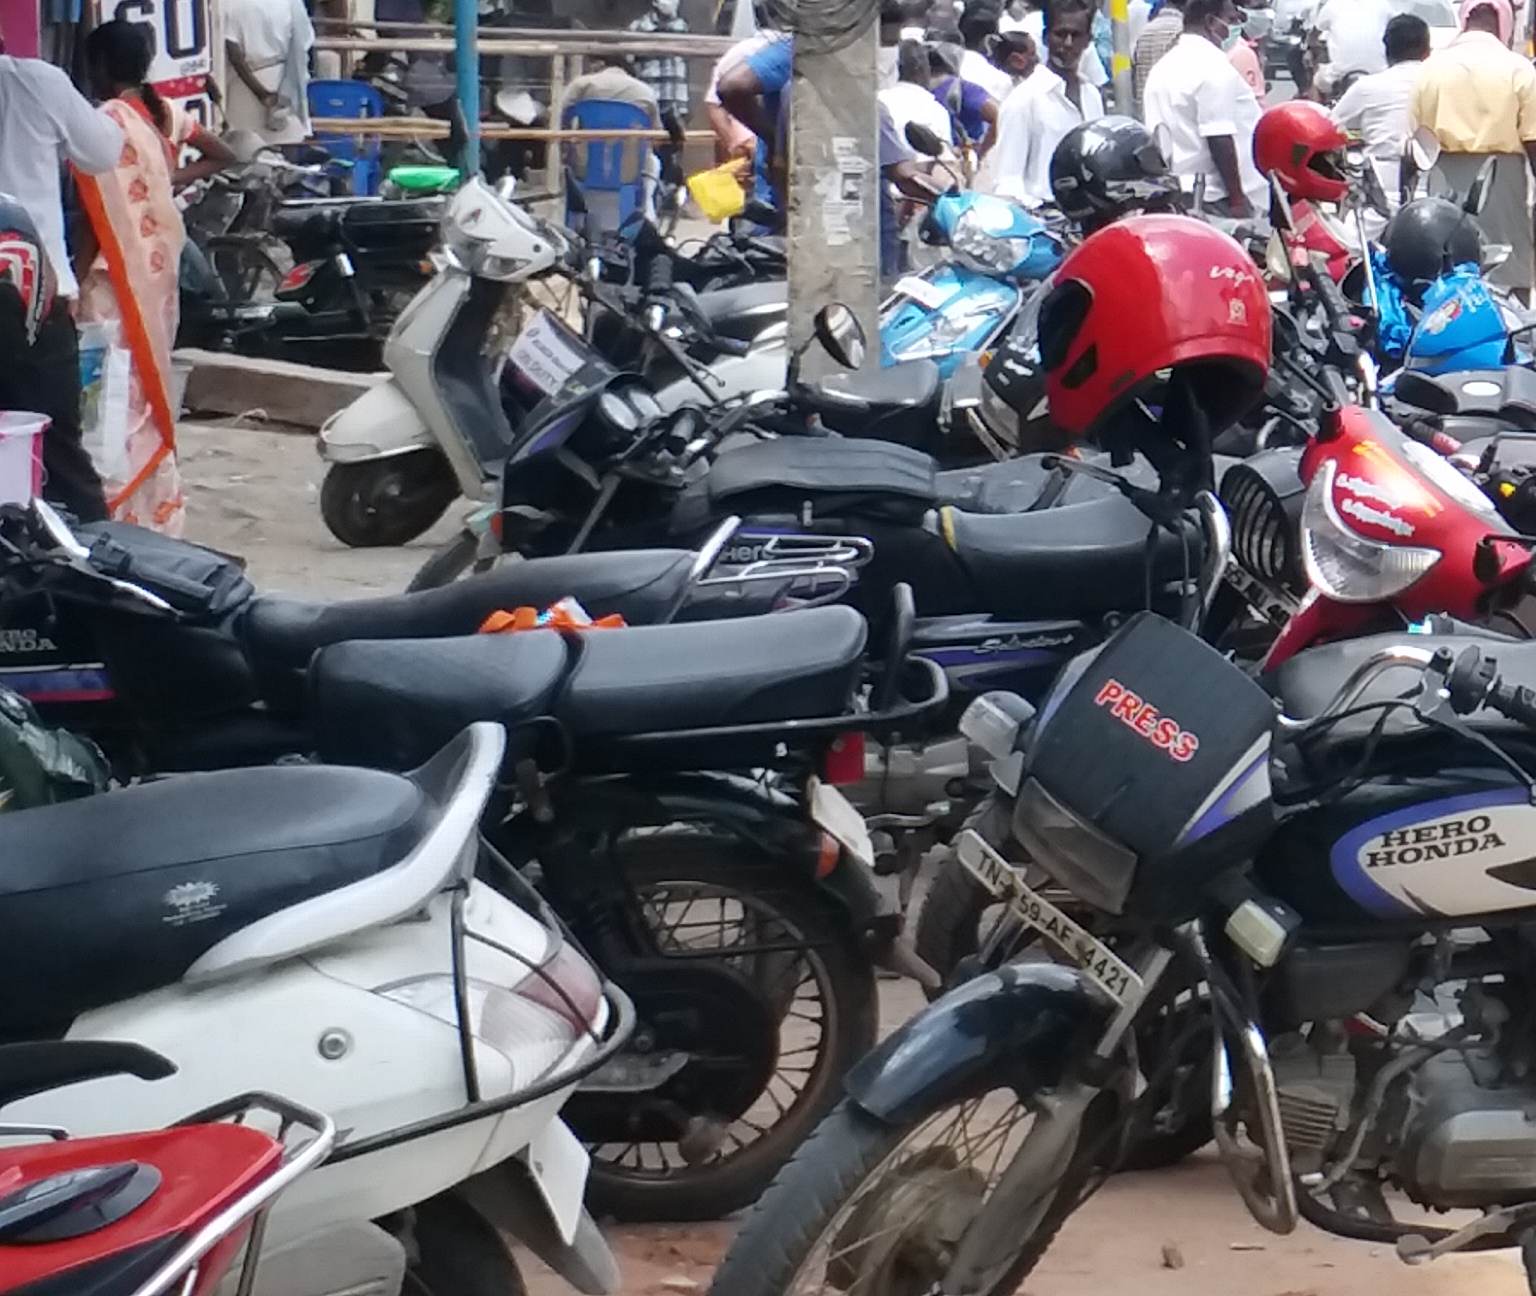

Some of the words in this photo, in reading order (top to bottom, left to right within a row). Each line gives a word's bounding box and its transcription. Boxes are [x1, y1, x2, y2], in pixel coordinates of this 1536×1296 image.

[1093, 678, 1199, 763] PRESS
[1381, 815, 1492, 848] HERO
[1366, 832, 1507, 868] HONDA
